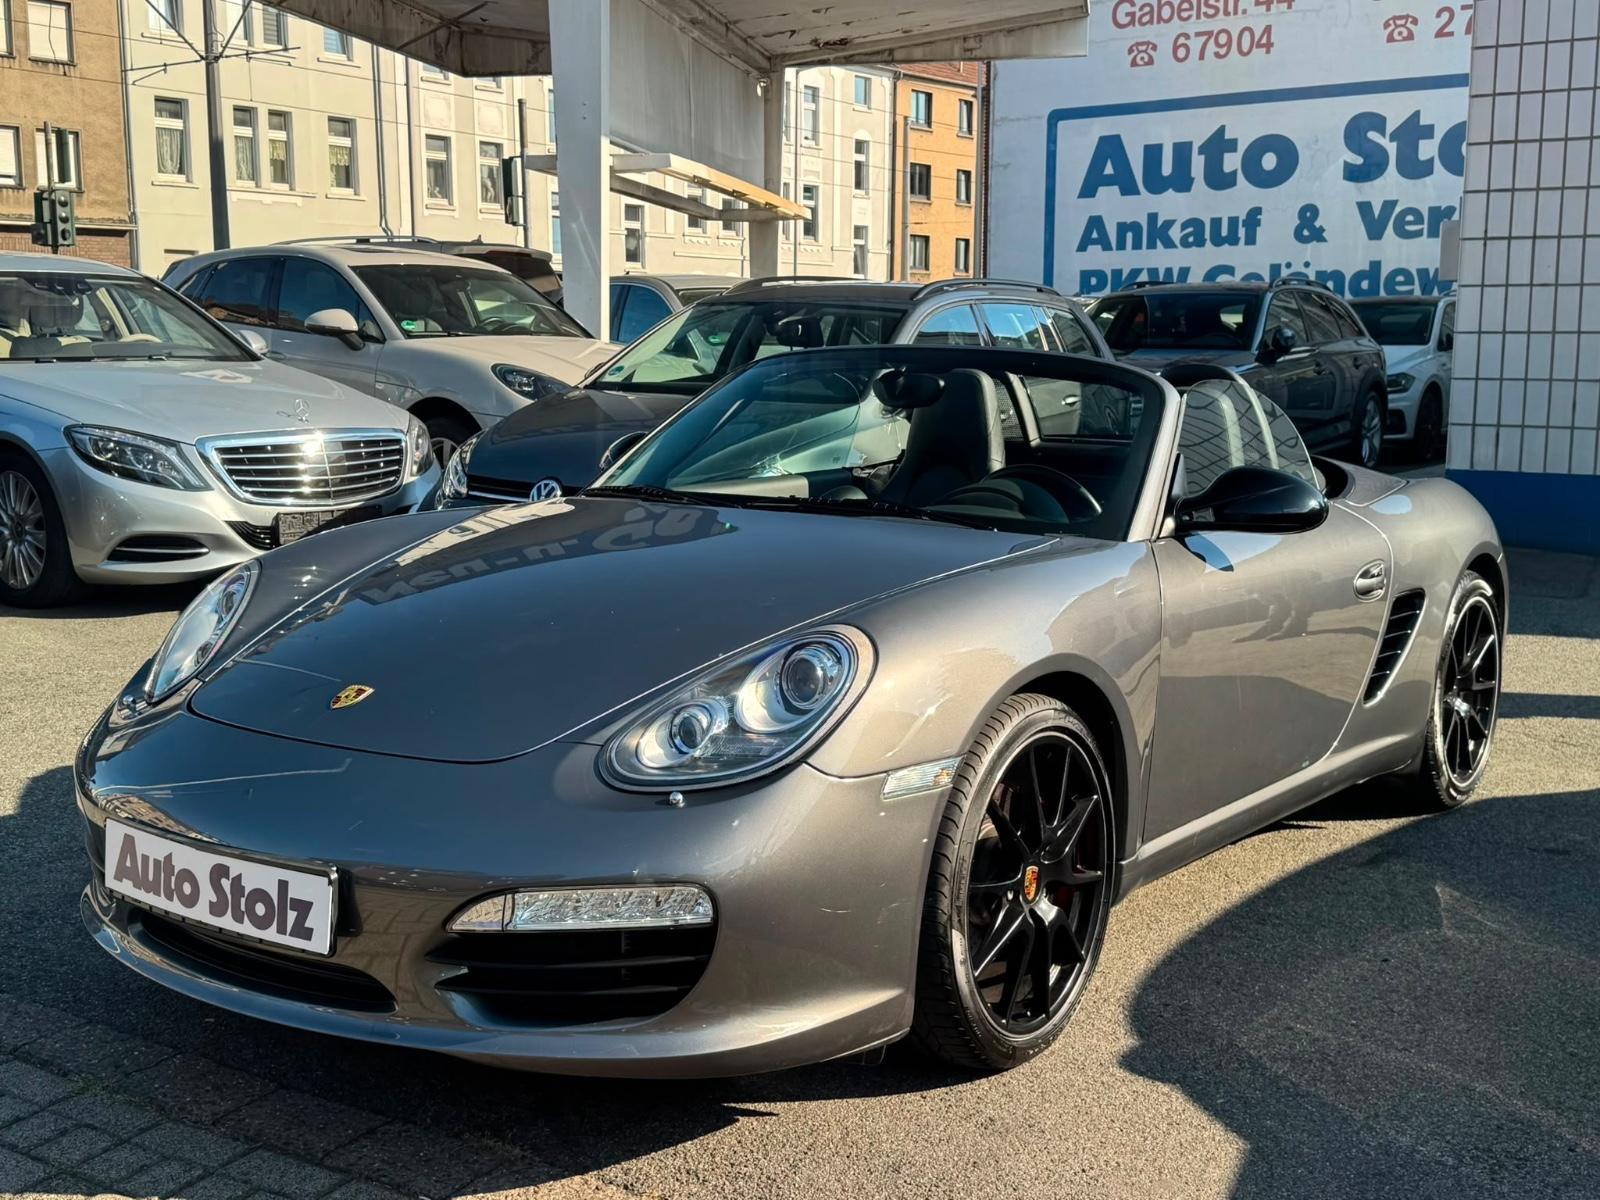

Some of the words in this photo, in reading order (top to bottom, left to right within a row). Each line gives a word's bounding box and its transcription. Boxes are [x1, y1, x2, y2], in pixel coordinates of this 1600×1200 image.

[1172, 25, 1274, 63] 67904
[1077, 124, 1299, 199] Auto
[1076, 206, 1262, 252] Ankauf
[1293, 203, 1328, 244] &
[1356, 199, 1457, 241] Ver
[113, 833, 200, 909] Auto
[209, 863, 314, 942] Stolz
